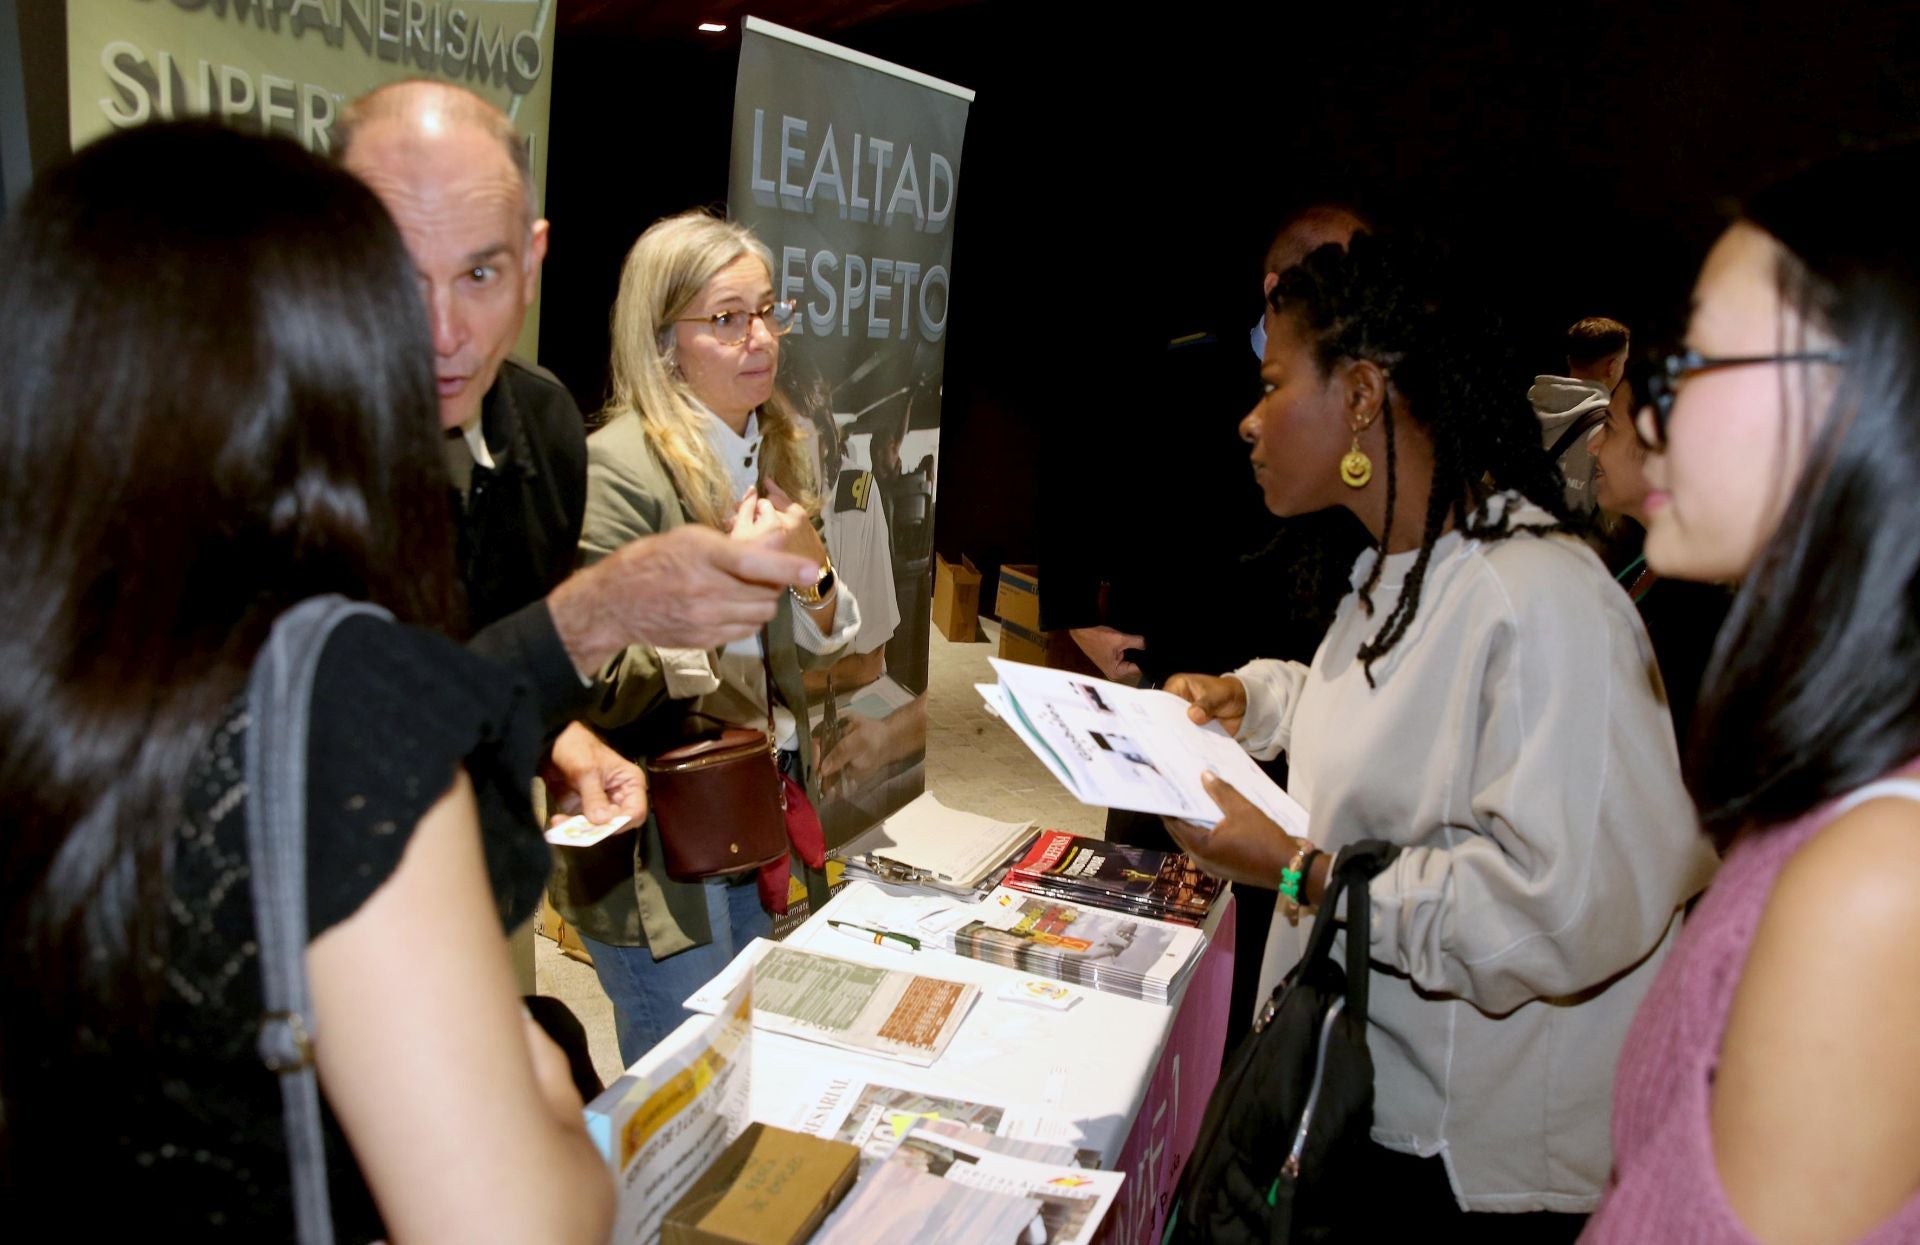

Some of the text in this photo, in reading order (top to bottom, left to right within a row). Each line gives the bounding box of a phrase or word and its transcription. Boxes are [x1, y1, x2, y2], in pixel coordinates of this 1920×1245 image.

[100, 41, 335, 152] SUPER
[752, 108, 954, 222] LEALTAD
[776, 246, 949, 333] ESPETO
[801, 1079, 852, 1133] RESARIAL
